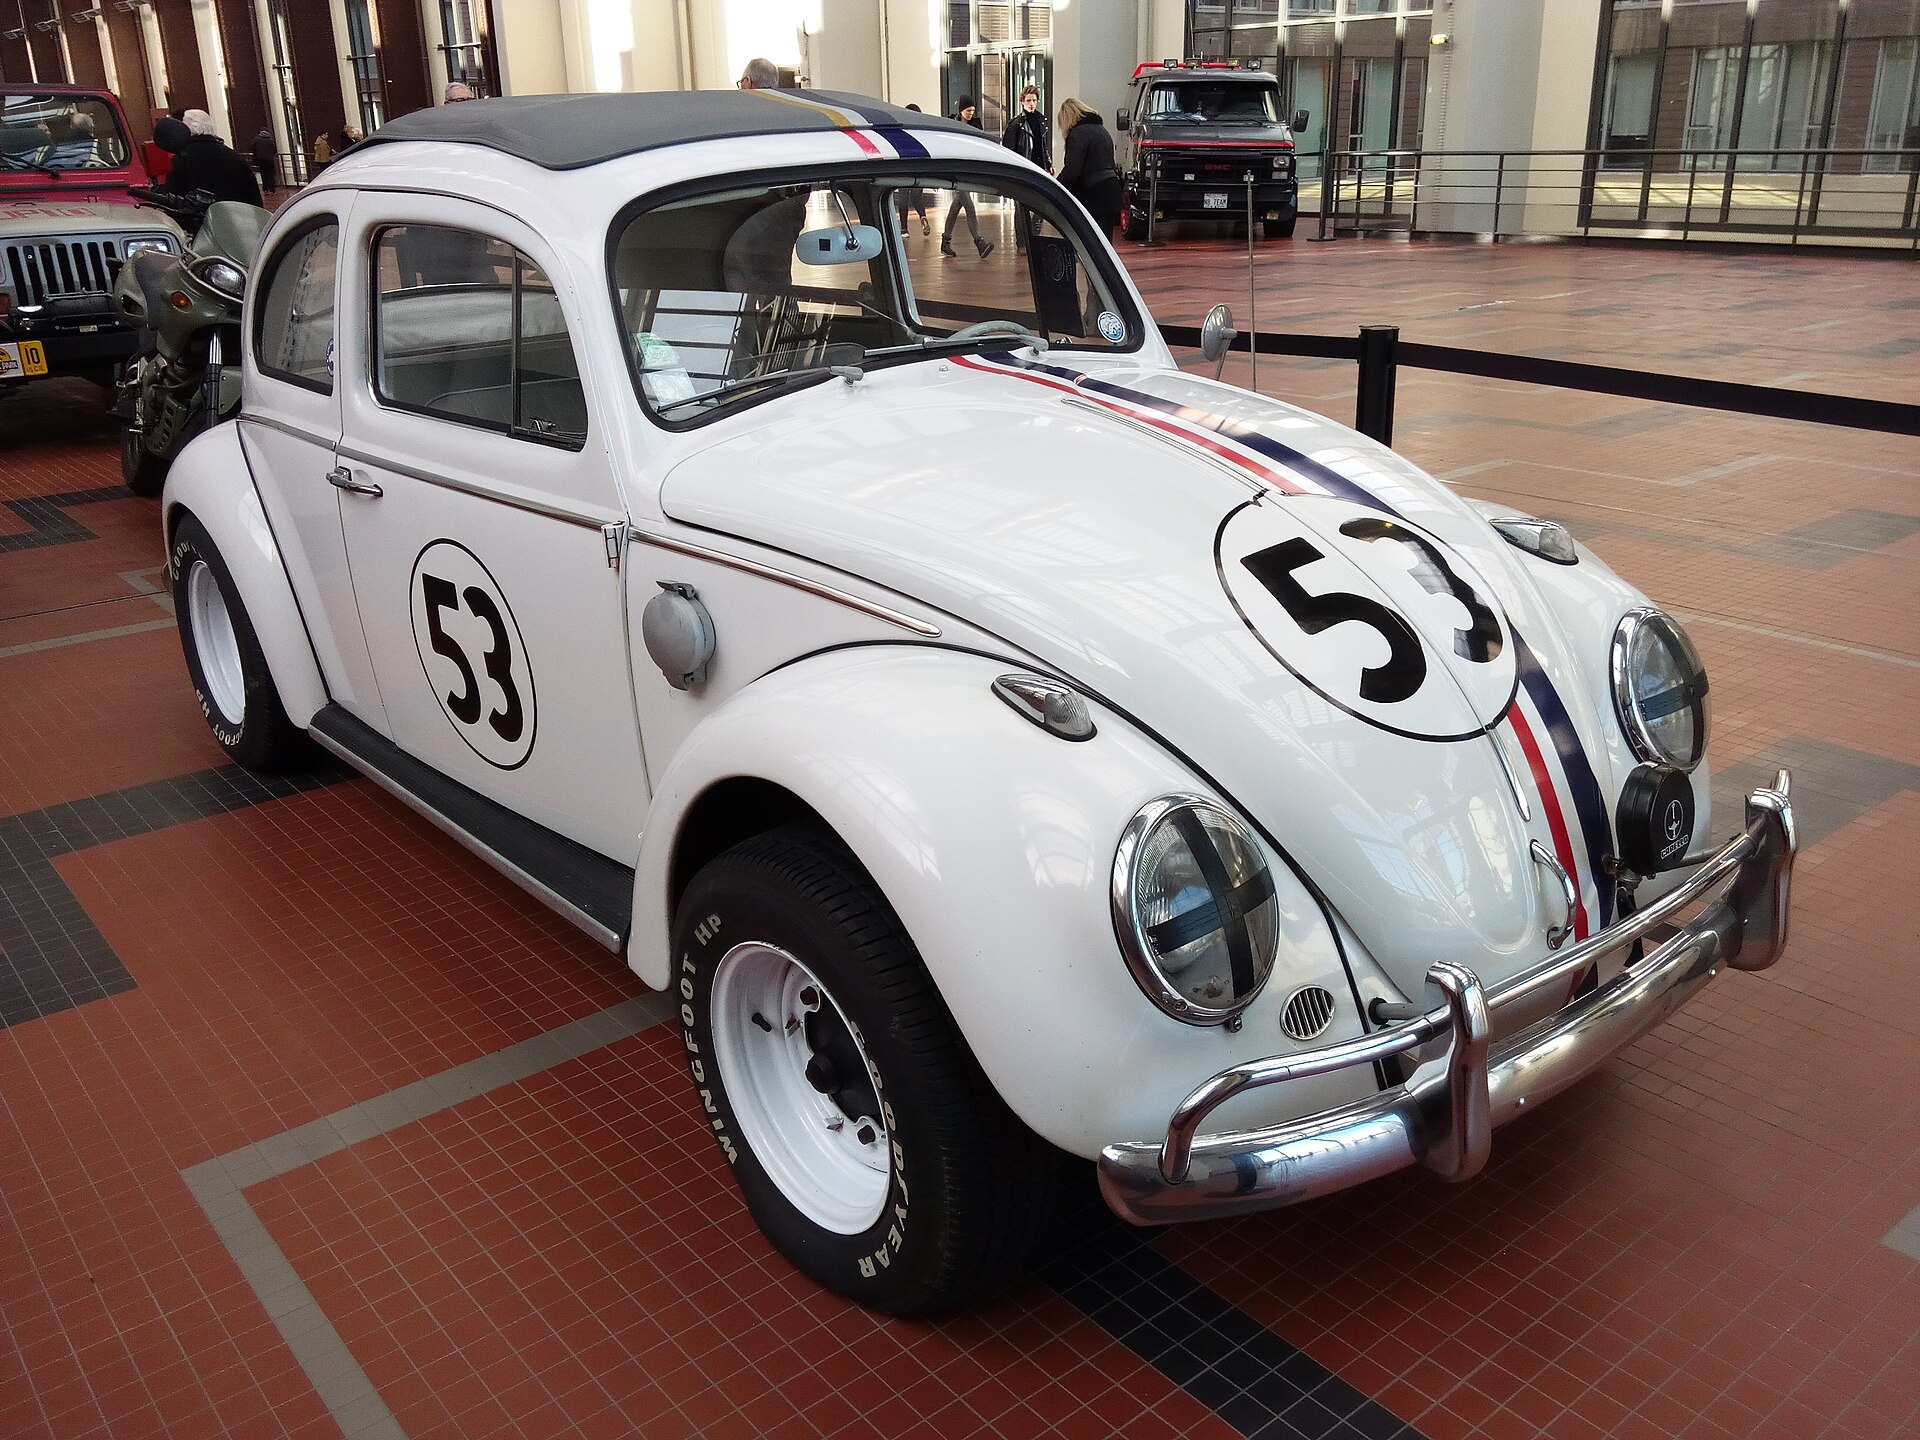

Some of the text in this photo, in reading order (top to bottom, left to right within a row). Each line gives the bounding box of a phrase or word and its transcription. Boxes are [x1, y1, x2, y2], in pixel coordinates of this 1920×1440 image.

[24, 347, 41, 365] 10
[421, 572, 524, 742] 53
[1240, 517, 1503, 703] 53
[679, 913, 738, 1165] WINGFOOT HP
[851, 1020, 909, 1278] GOODYEAR
